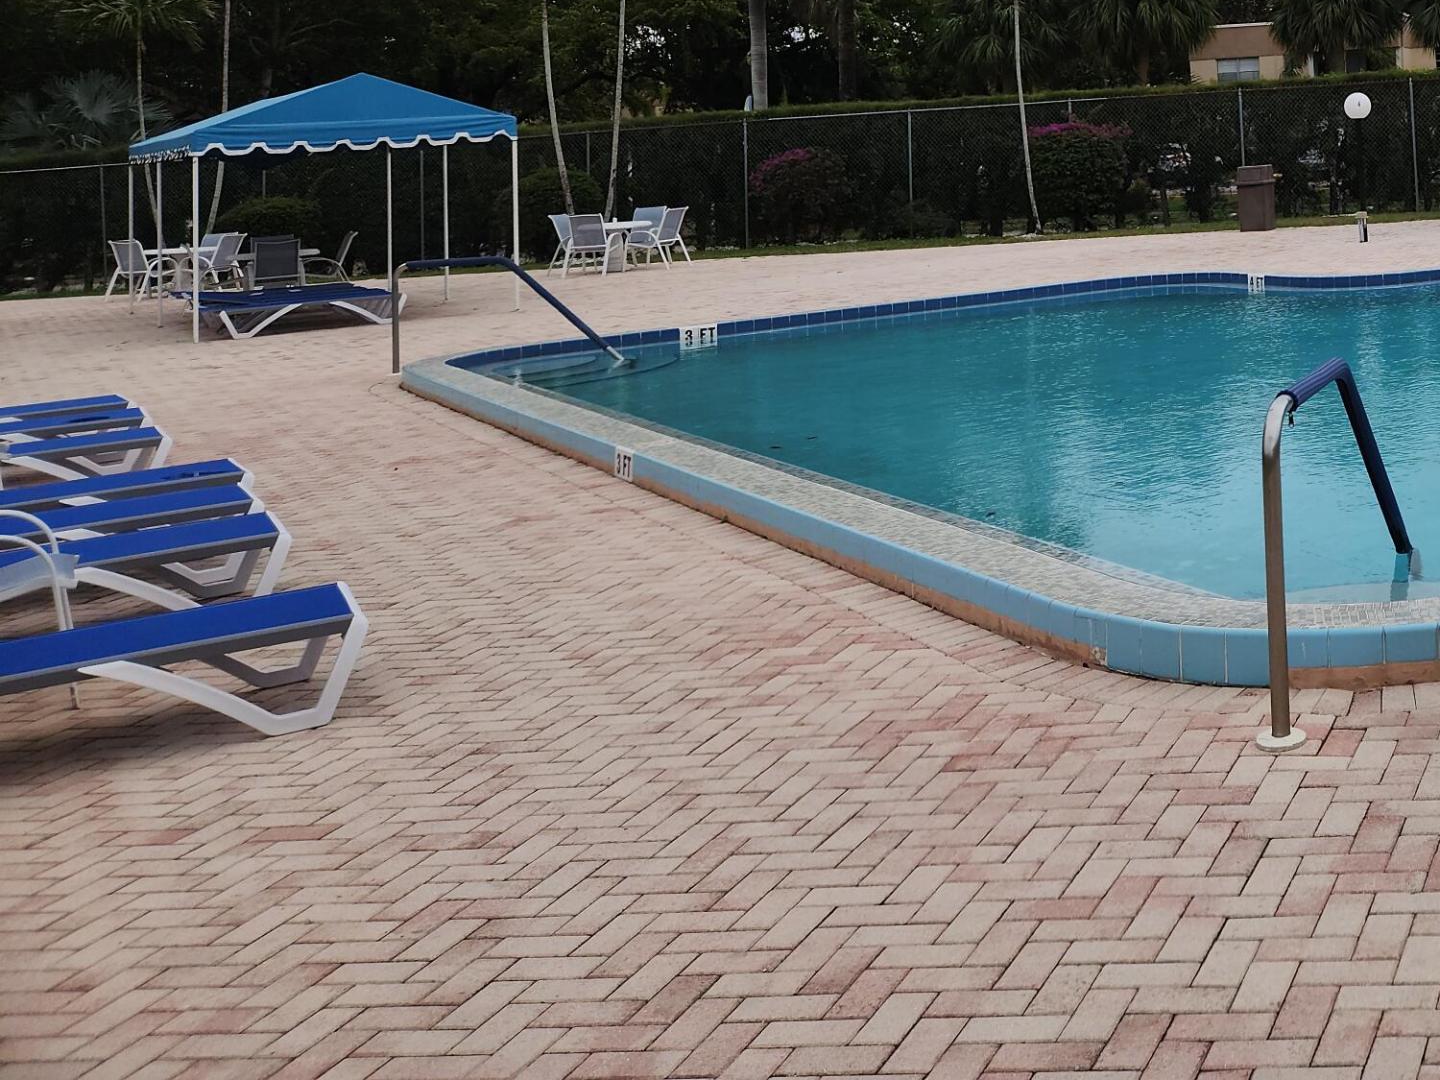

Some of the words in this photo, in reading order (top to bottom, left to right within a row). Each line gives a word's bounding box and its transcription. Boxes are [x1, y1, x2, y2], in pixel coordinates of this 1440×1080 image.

[684, 329, 693, 347] 3
[700, 326, 716, 345] FT
[622, 454, 632, 478] FT
